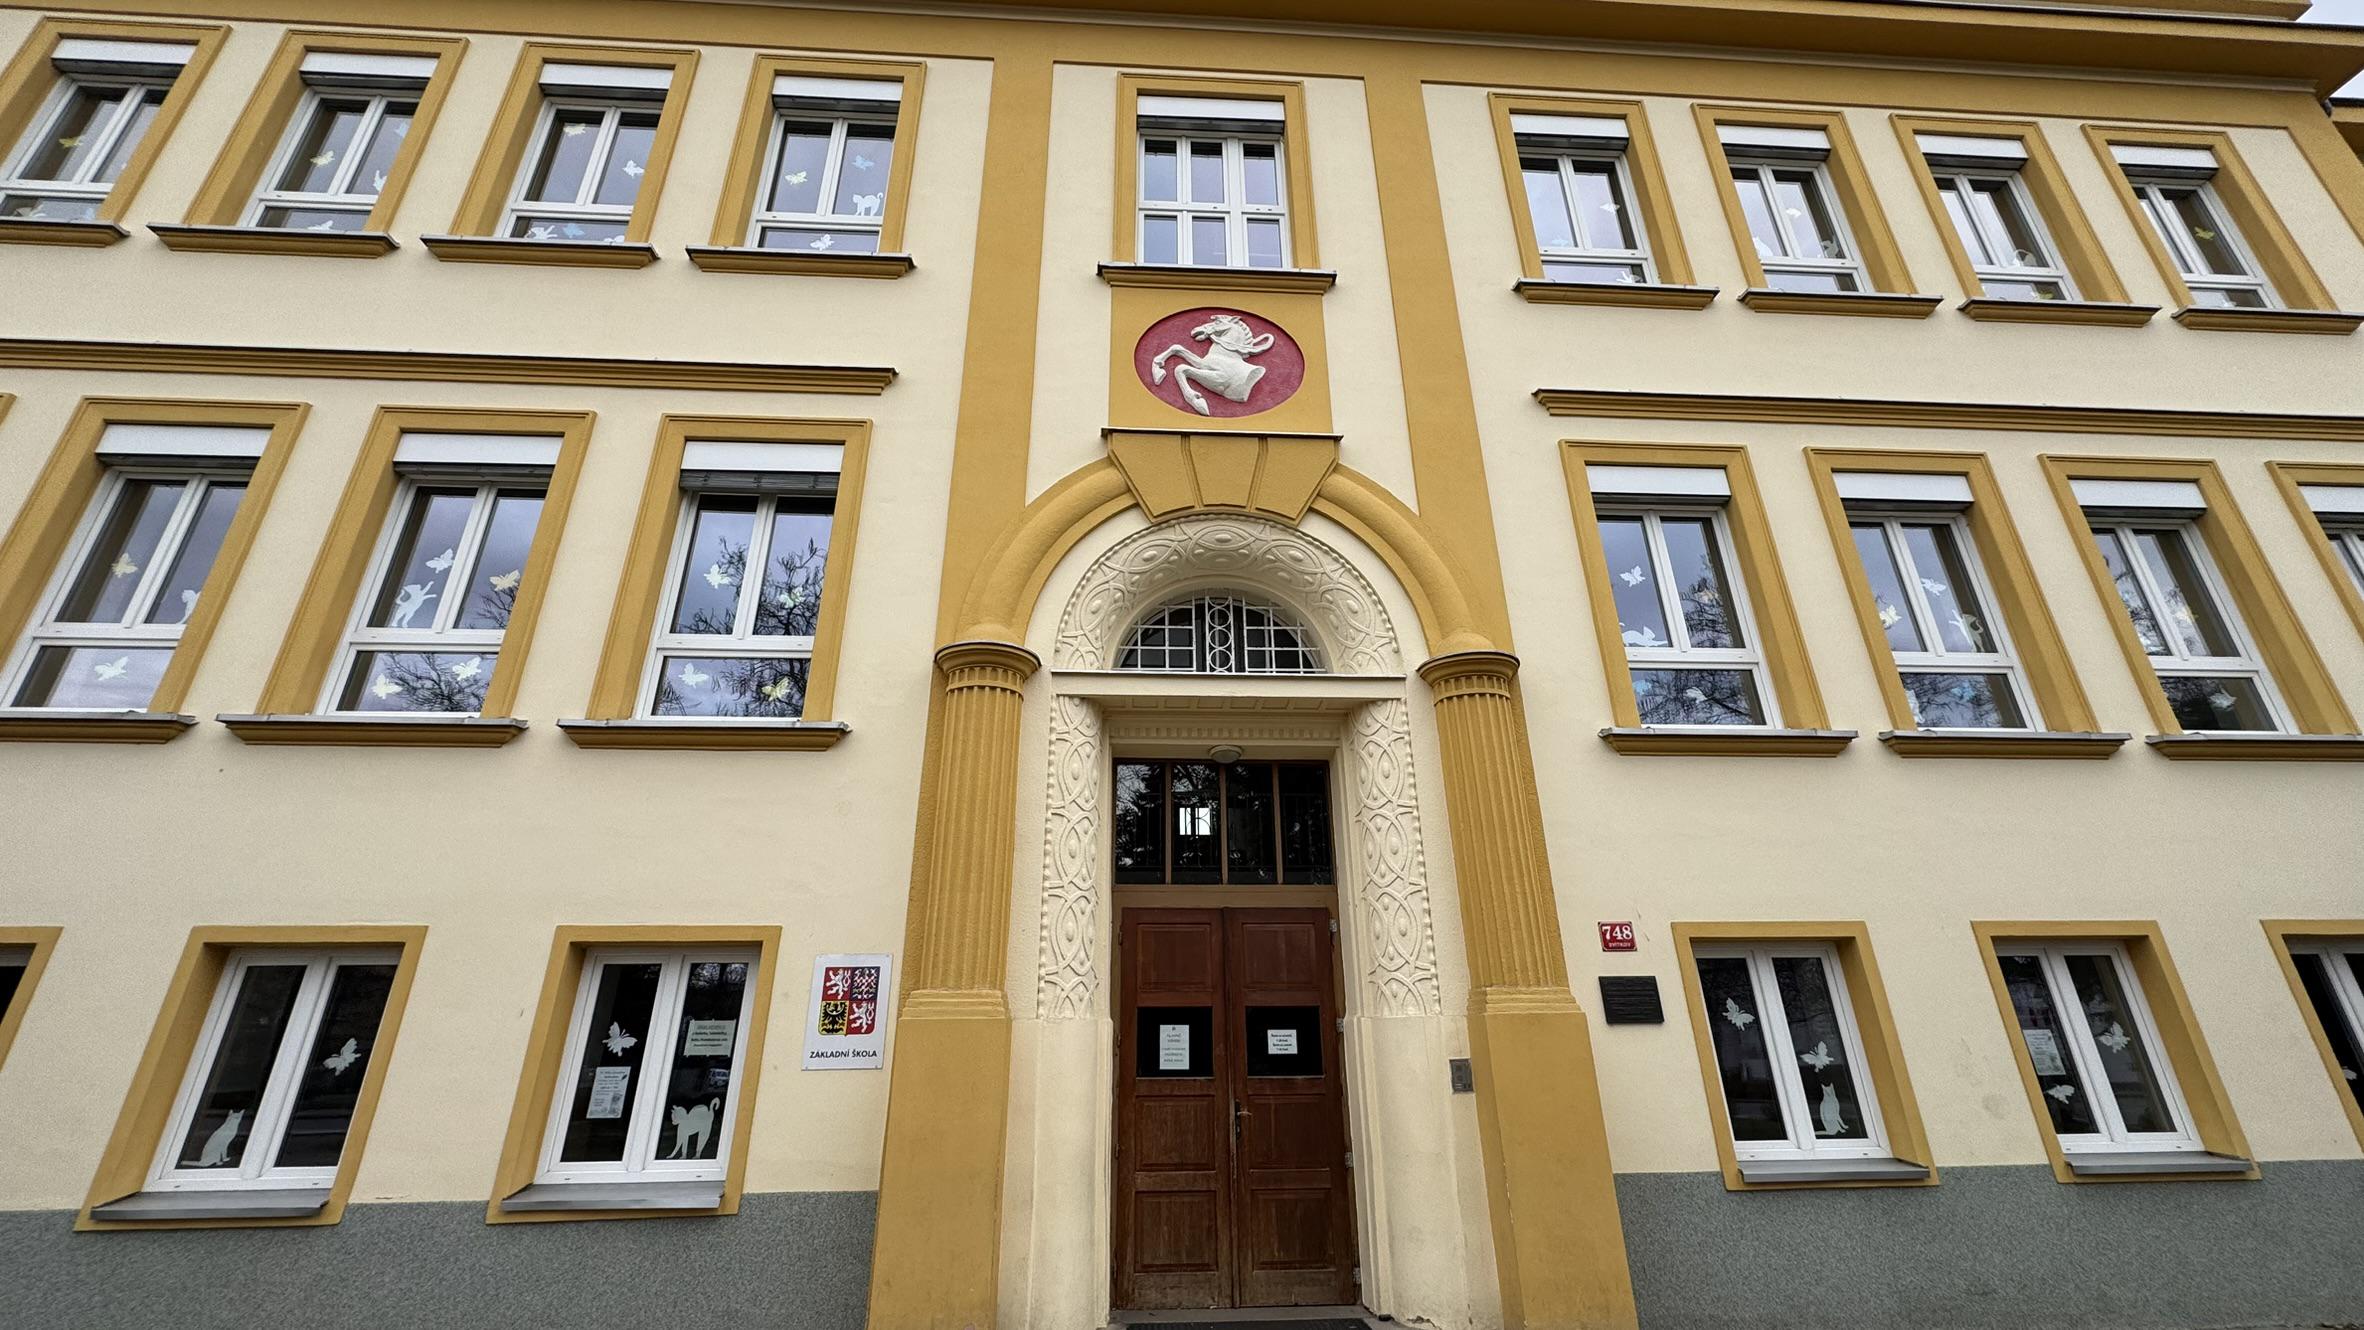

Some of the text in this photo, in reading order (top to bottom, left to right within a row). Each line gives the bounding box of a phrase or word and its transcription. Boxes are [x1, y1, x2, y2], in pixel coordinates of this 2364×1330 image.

[1602, 925, 1632, 940] 748
[809, 1048, 878, 1059] ZÁKLADNÍ ŠKOLA
